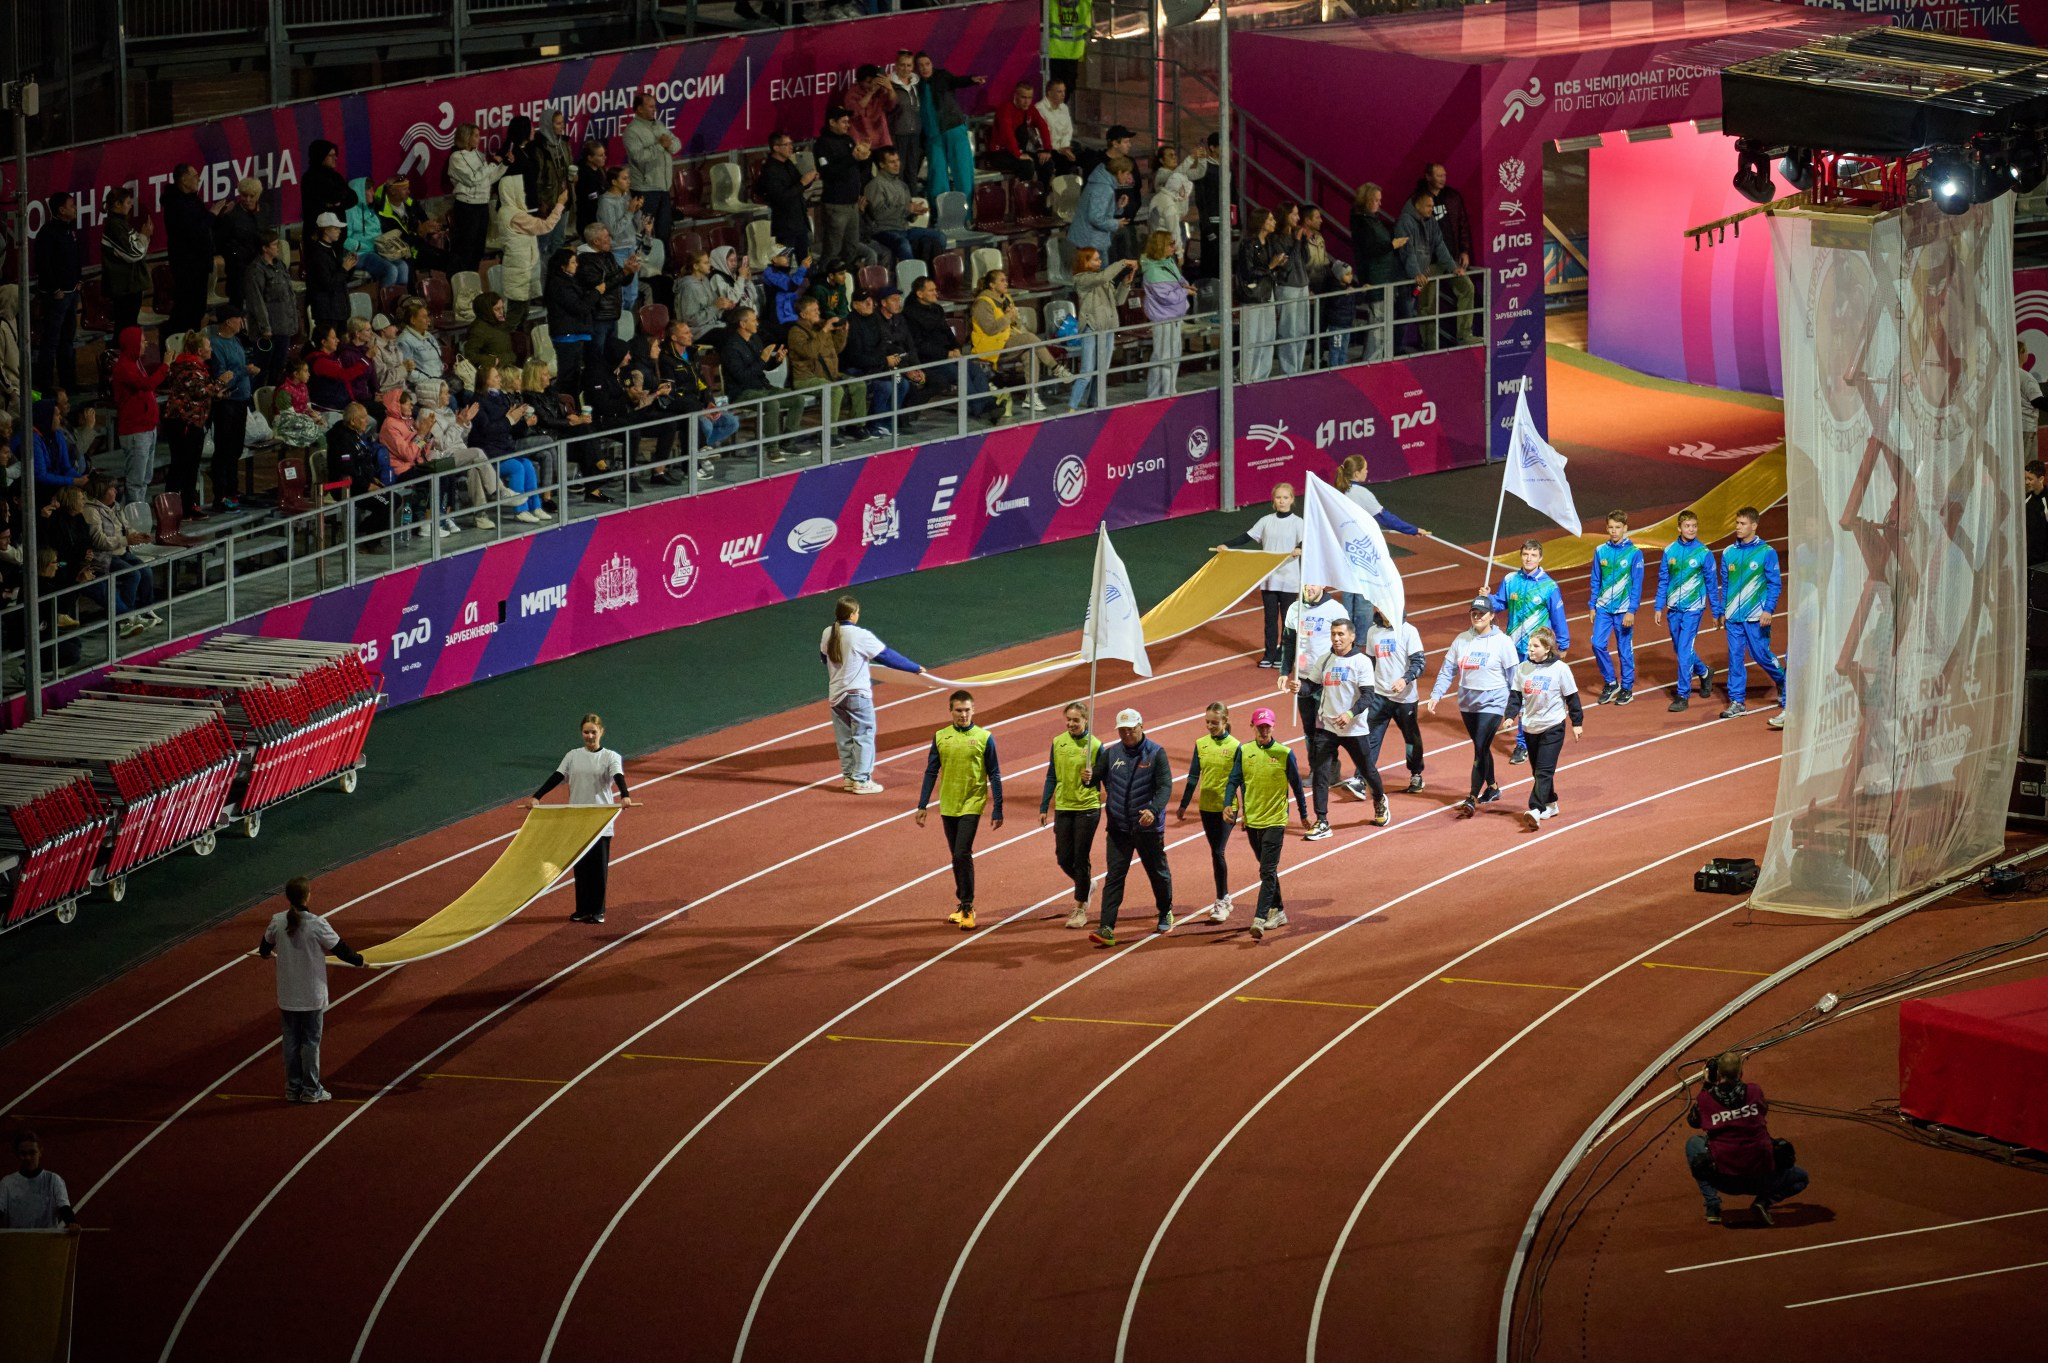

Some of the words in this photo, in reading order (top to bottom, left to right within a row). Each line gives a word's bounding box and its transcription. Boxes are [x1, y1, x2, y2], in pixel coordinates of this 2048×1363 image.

[1921, 4, 2020, 32] АТЛЕТИКЕ
[770, 63, 897, 101] ЕКАТЕРИ
[1554, 79, 1581, 96] ПСБ
[1584, 68, 1665, 92] ЧЕМПИОНАТ
[1554, 98, 1573, 113] ПО
[1575, 86, 1625, 110] ЛЕГКОЙ
[1627, 82, 1690, 104] АТЛЕТИКЕ
[475, 104, 514, 131] ПСБ
[148, 148, 298, 214] ТИБУНА
[1508, 233, 1533, 249] ПСБ
[1339, 417, 1376, 442] ПСБ
[1107, 457, 1165, 480] buyson
[520, 584, 568, 618] МАТЧ!
[445, 621, 499, 647] ЗАРУБЕЖНЕФТЬ
[357, 639, 379, 665] СБ
[1710, 1103, 1759, 1126] PRESS
